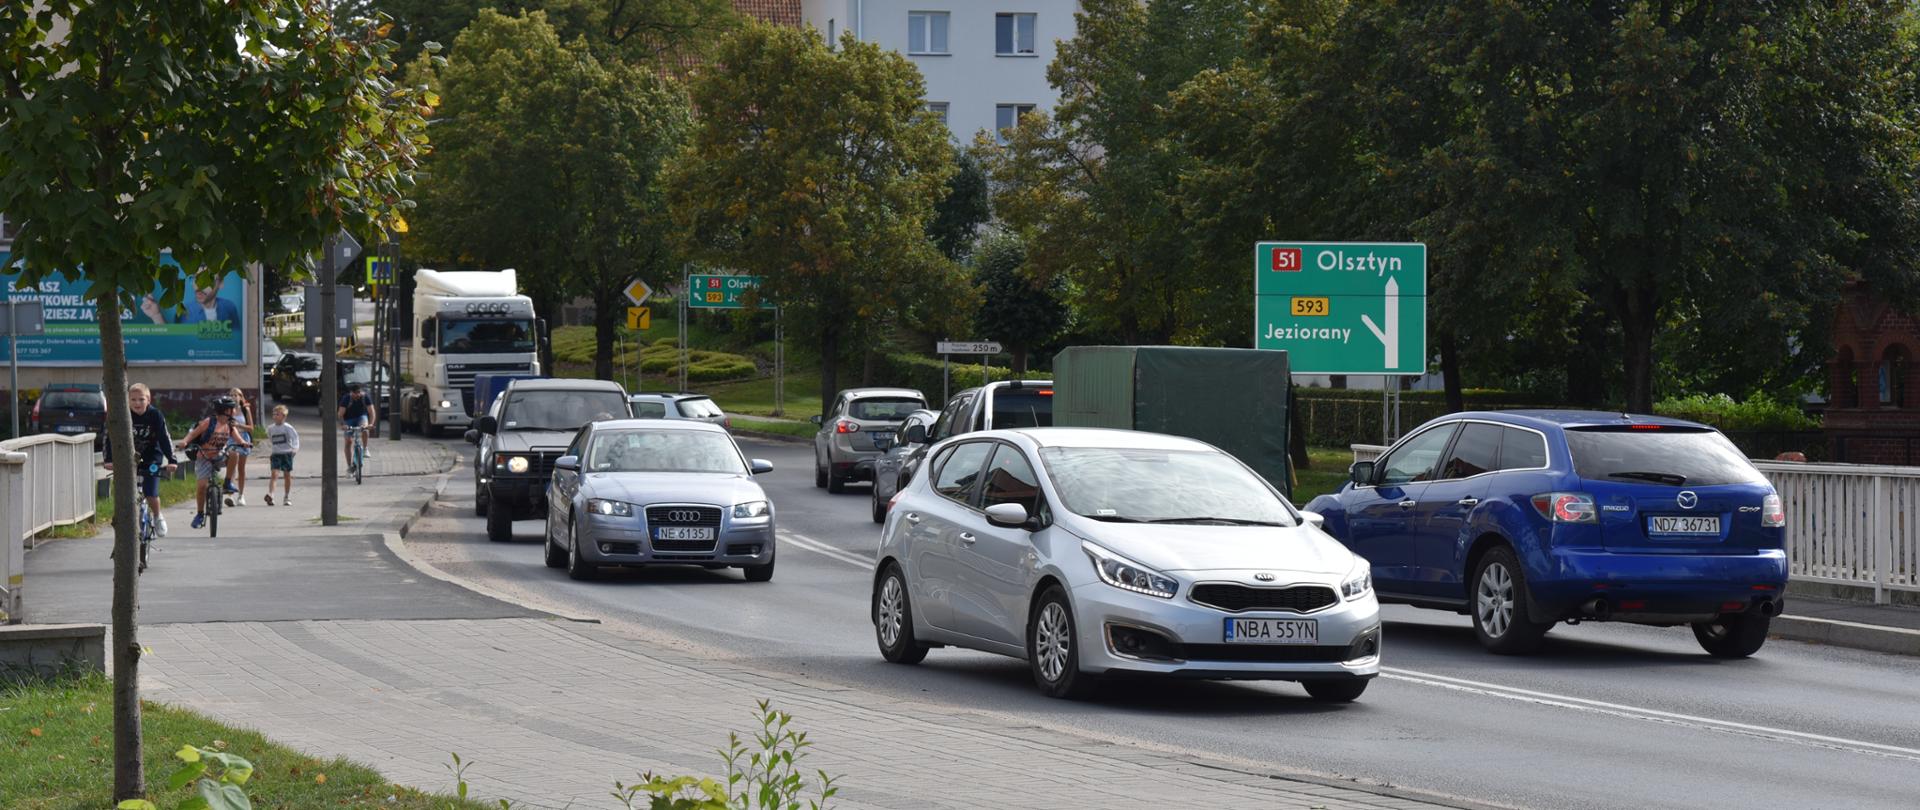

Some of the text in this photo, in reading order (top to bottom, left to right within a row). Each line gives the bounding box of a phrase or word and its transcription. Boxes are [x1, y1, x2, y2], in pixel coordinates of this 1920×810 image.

[1279, 250, 1401, 276] 51 Olsztyn
[707, 292, 722, 301] 593
[1297, 300, 1324, 313] 593
[79, 308, 94, 322] JĄ
[1265, 324, 1351, 344] Jeziorany
[973, 344, 989, 352] 250
[1654, 517, 1719, 533] NDZ 36731
[661, 528, 711, 539] NE 6135J
[1256, 573, 1274, 581] KIA
[1236, 621, 1314, 639] NBA 55YN
